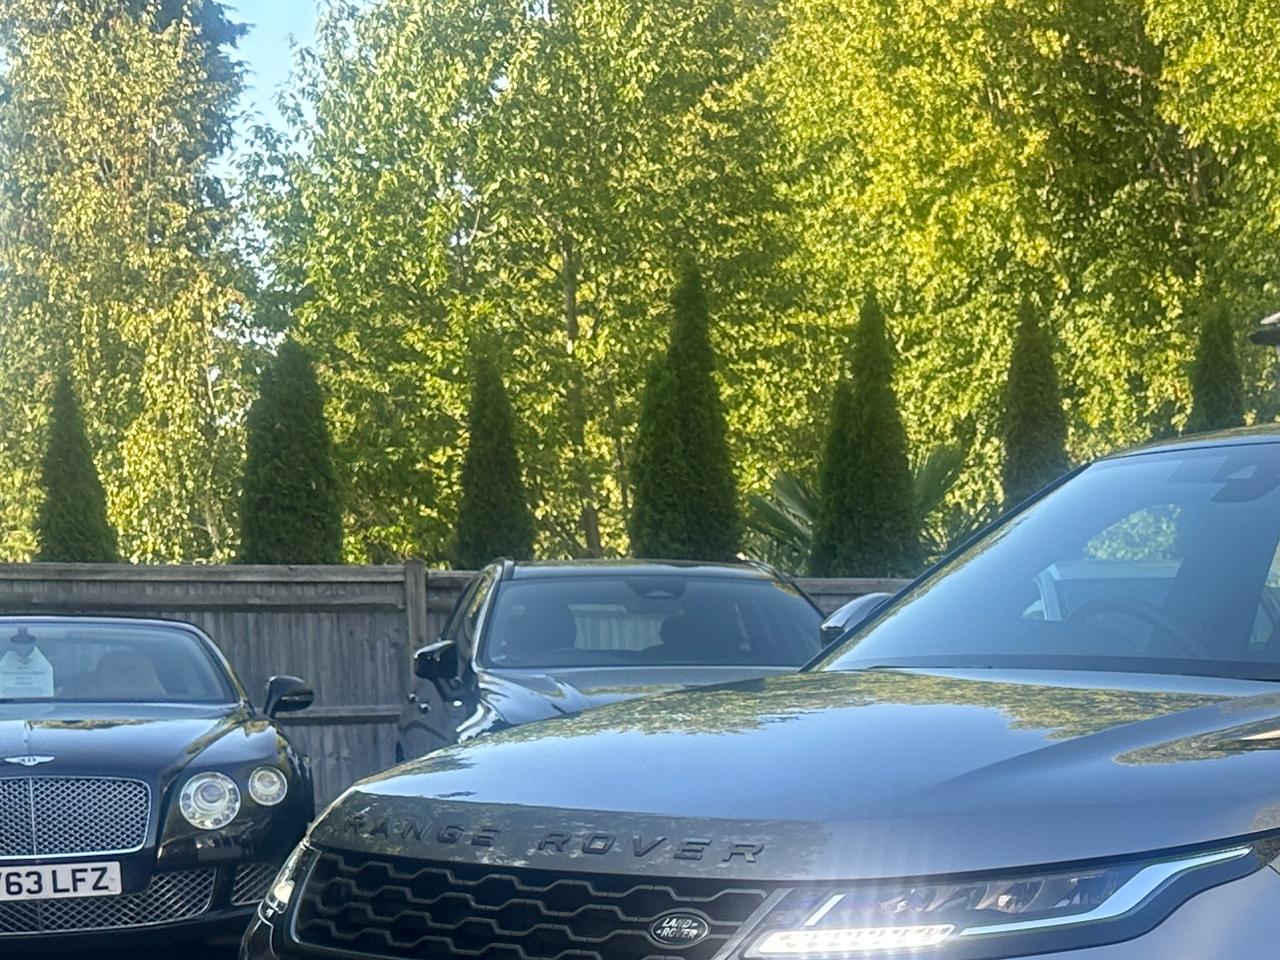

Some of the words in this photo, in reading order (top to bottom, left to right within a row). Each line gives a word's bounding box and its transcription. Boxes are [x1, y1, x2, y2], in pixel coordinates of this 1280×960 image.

[536, 833, 765, 863] ROVER
[0, 871, 43, 896] 63
[51, 867, 109, 893] LFZ
[660, 927, 698, 939] ROVER
